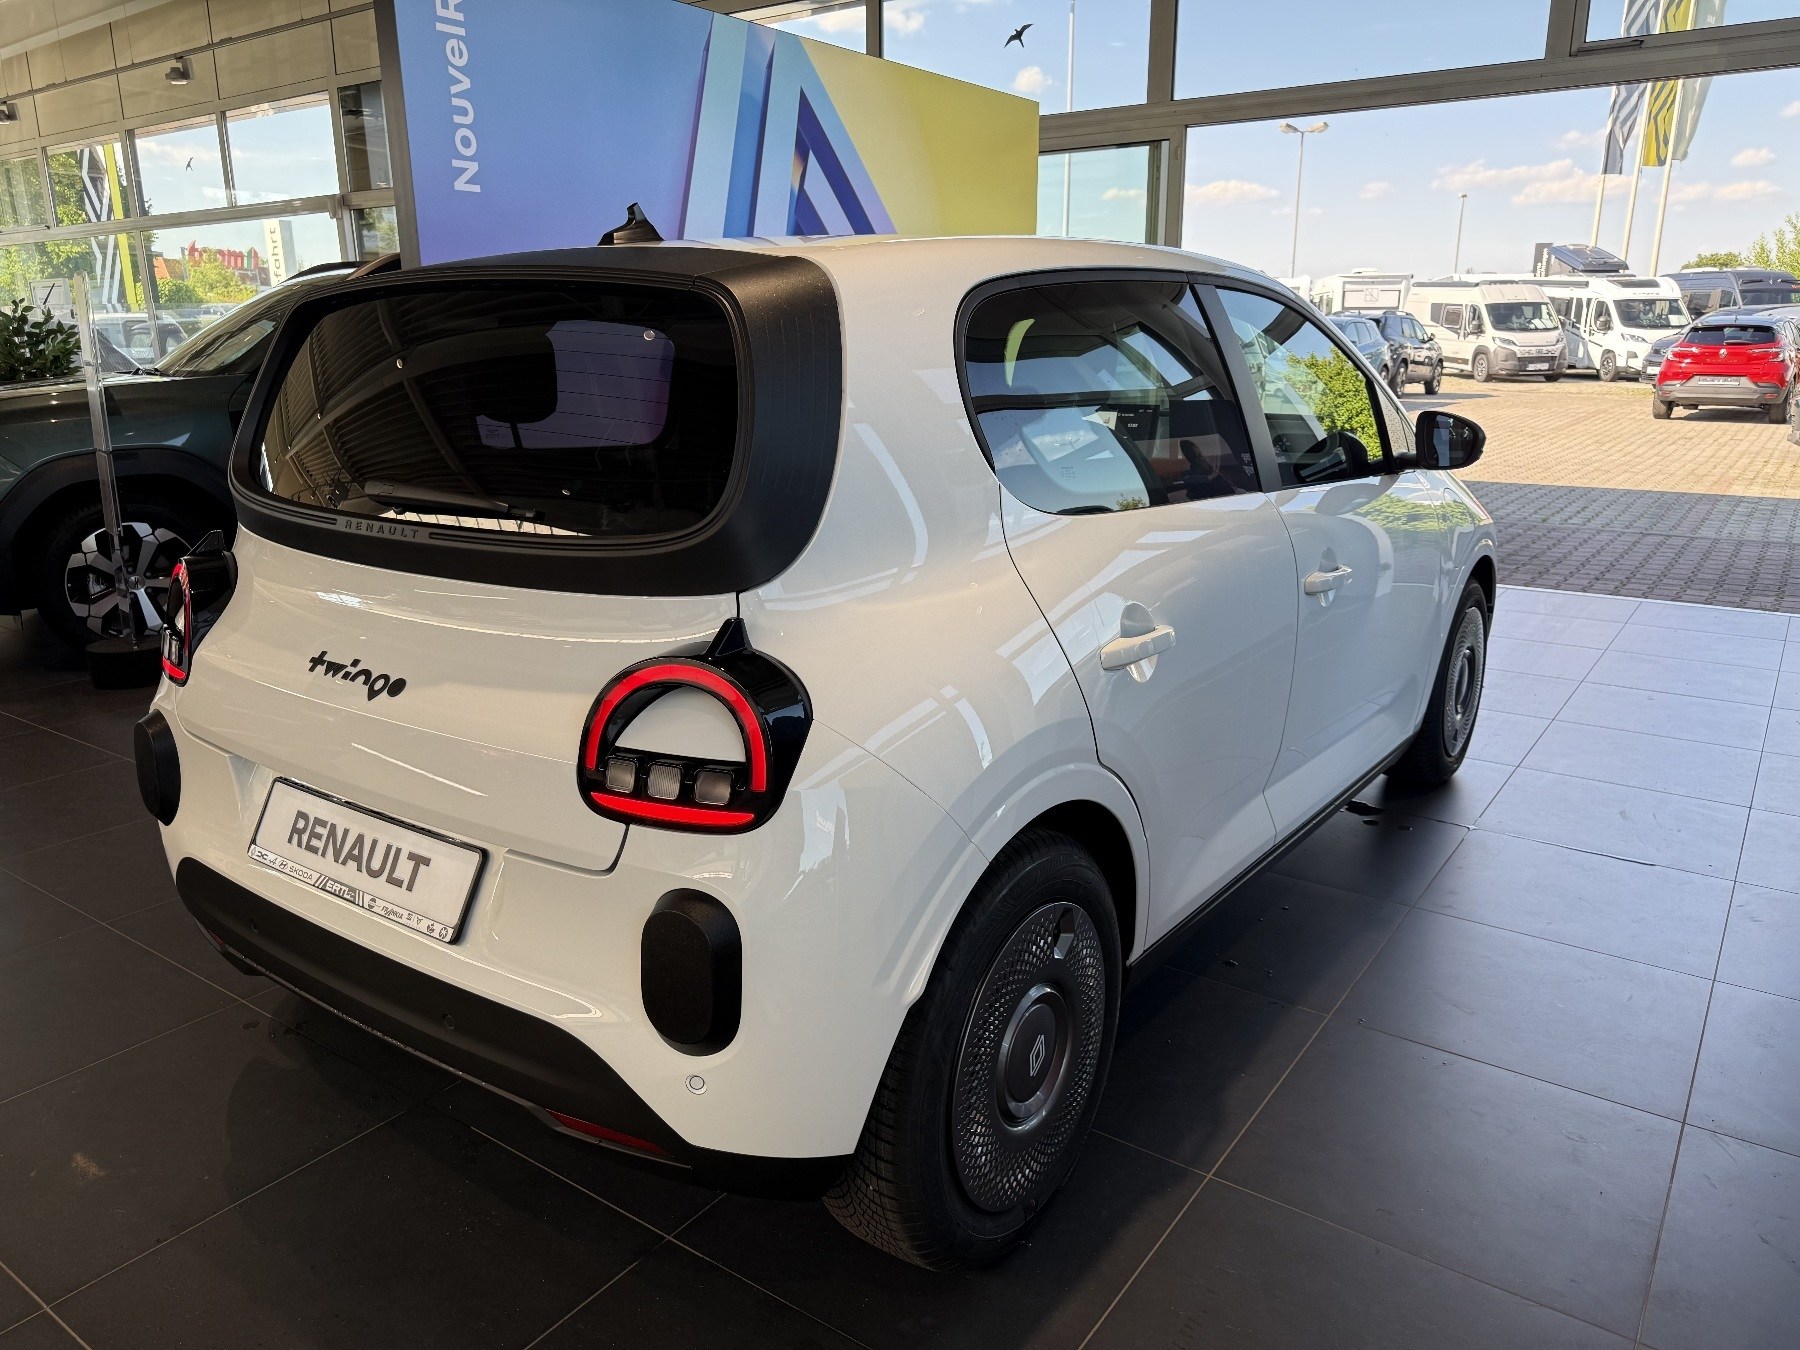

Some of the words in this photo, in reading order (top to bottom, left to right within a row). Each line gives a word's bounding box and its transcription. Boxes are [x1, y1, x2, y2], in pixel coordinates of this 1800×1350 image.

[270, 227, 281, 282] fahrt
[345, 519, 419, 538] RENAULT
[308, 650, 407, 701] twingo
[287, 810, 431, 892] RENAULT
